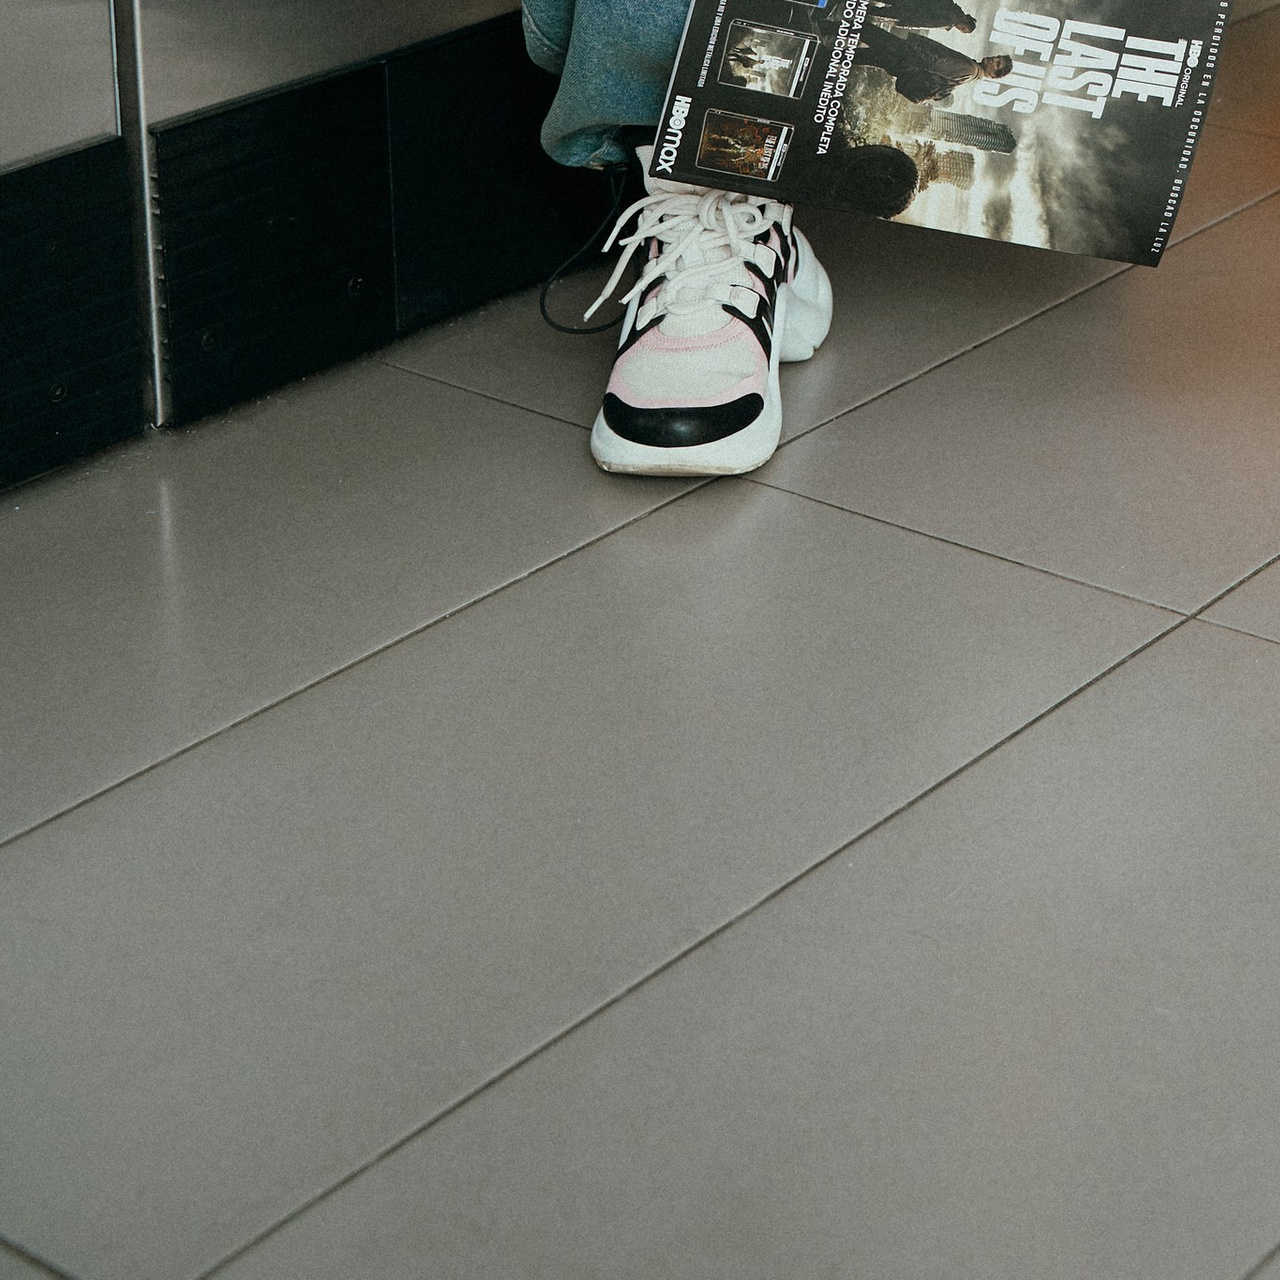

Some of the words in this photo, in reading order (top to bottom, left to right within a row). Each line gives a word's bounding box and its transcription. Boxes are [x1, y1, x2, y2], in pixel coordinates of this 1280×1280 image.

[825, 19, 851, 79] ADICIONAL
[987, 6, 1060, 63] OF
[1186, 39, 1204, 68] HBO
[1205, 13, 1226, 68] PERDIDOS
[832, 32, 861, 98] TEMPORADA
[971, 60, 1046, 113] US
[1040, 18, 1126, 120] LAST
[1109, 35, 1188, 107] THE
[1174, 67, 1192, 108] ORIGINAL
[1201, 74, 1212, 87] EN
[813, 81, 834, 126] INÉDITO
[1196, 92, 1207, 104] LA
[655, 95, 692, 174] HBOmax
[816, 99, 841, 155] COMPLETA
[1163, 178, 1183, 218] BUSCAD
[1151, 237, 1164, 253] LUZ
[1158, 222, 1169, 233] LA
